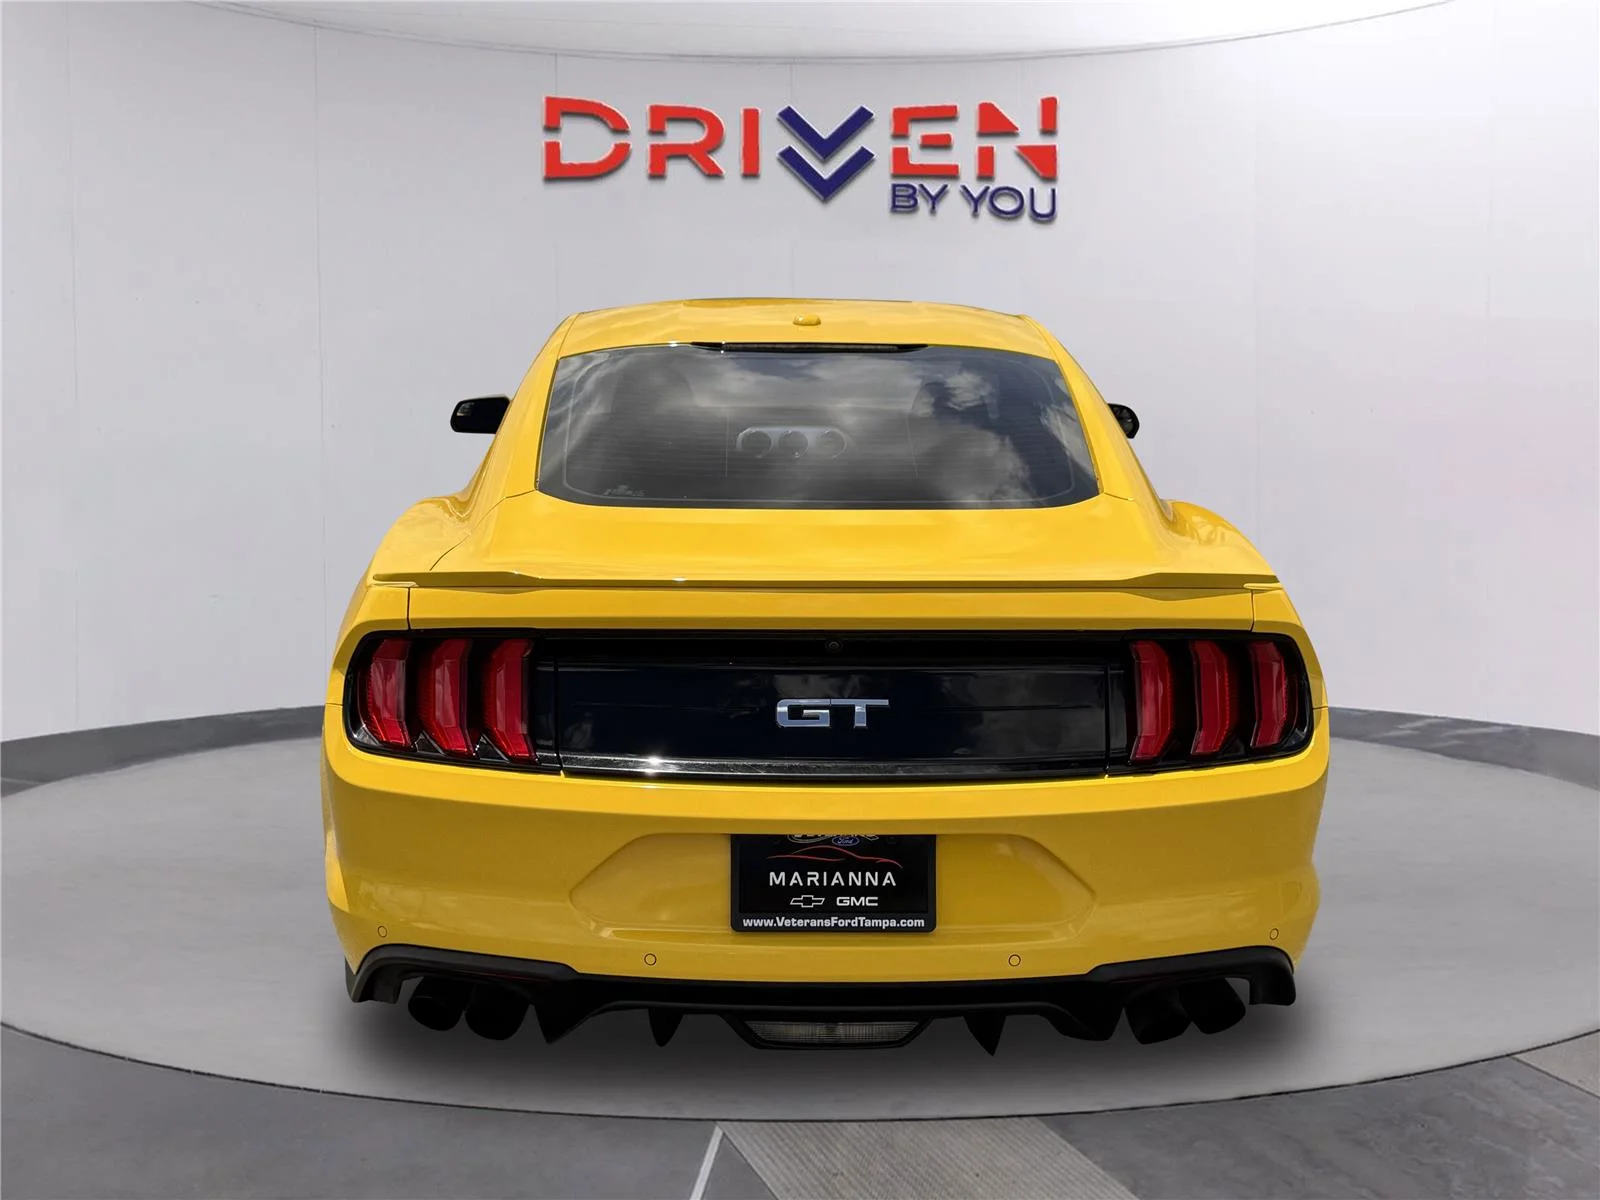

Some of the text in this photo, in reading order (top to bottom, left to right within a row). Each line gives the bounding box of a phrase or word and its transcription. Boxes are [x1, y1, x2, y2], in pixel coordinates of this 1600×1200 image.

[543, 96, 1058, 203] DRIVEN
[890, 183, 1057, 221] BY YOU
[776, 698, 889, 727] GT
[768, 871, 897, 887] MARIANNA
[836, 896, 879, 906] GMC
[742, 916, 925, 929] www.VeteransFordTampa.com
